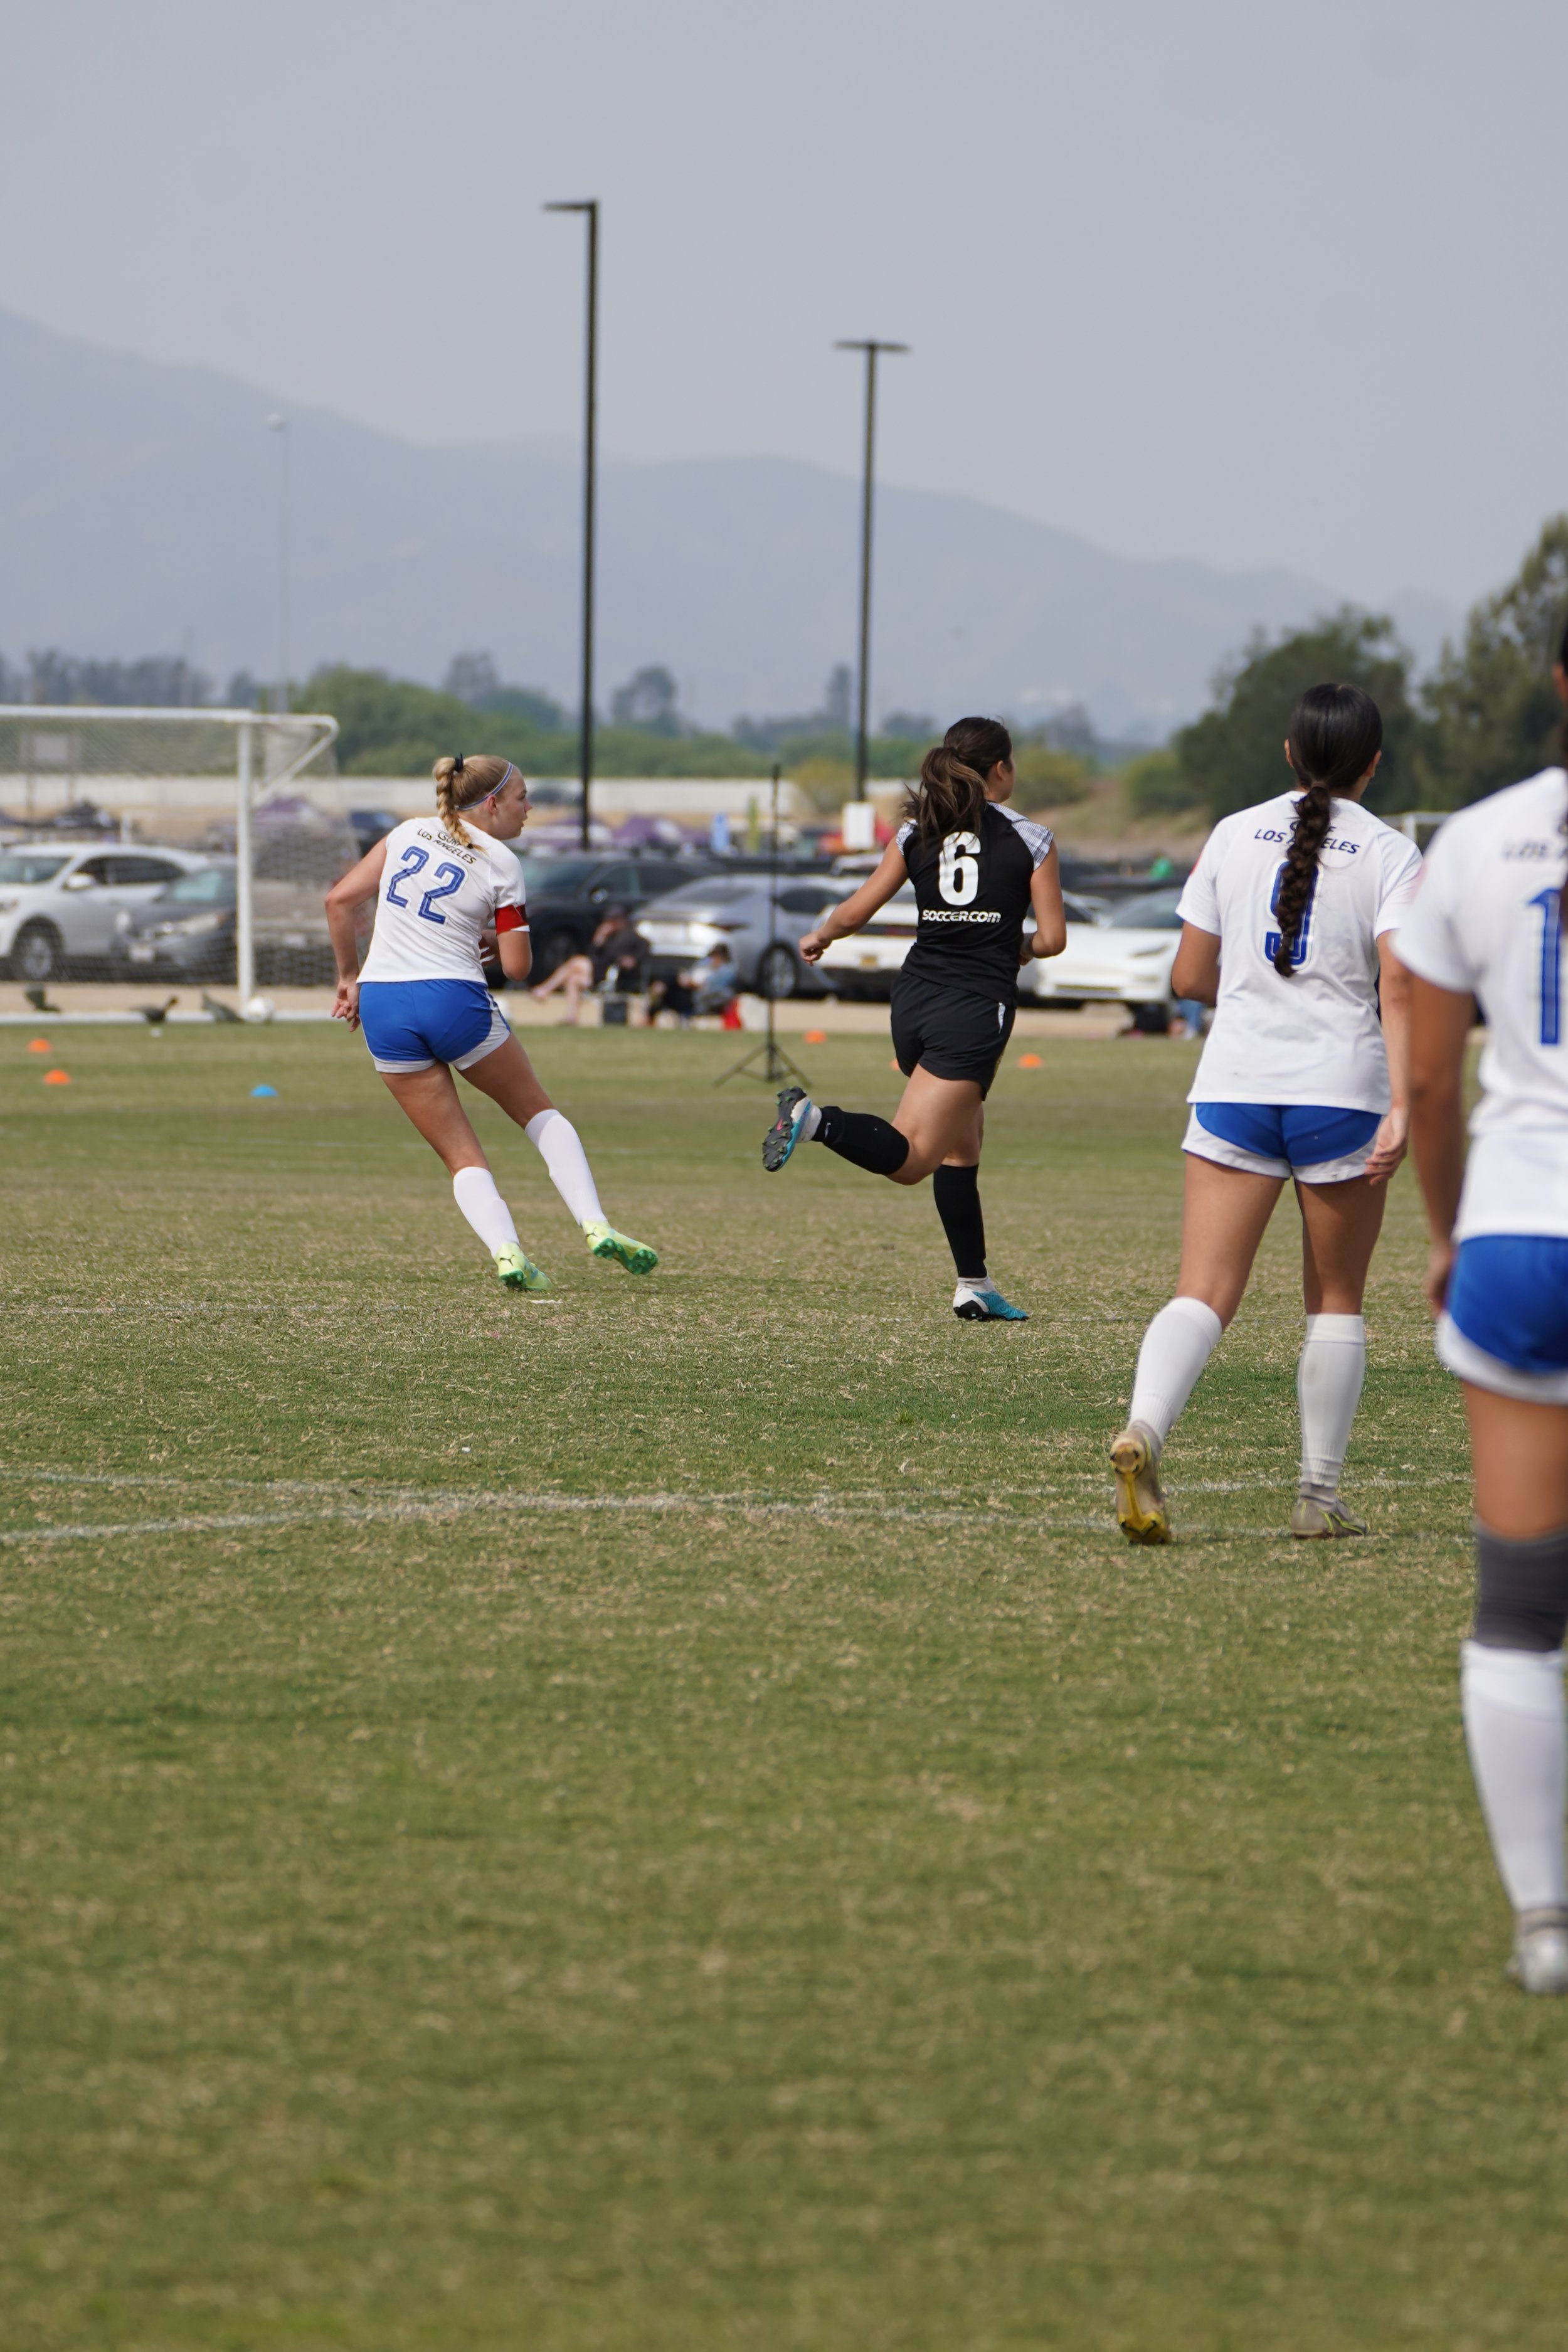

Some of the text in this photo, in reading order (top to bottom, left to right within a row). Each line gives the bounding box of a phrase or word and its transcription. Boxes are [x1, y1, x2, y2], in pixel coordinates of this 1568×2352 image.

[433, 840, 477, 864] ANGELES
[1254, 829, 1286, 842] LOS
[386, 846, 465, 924] 22
[939, 831, 981, 906] 6
